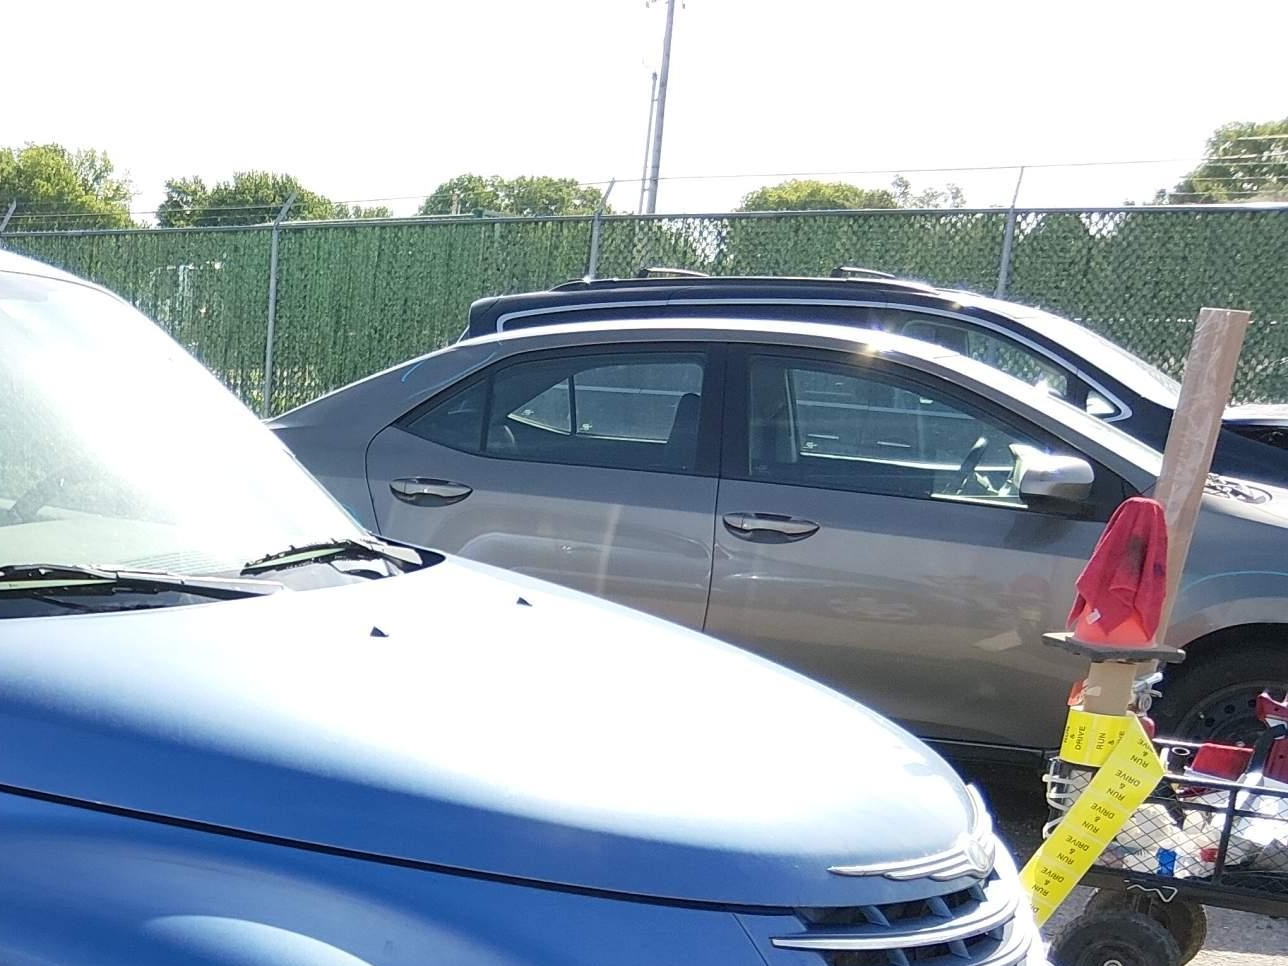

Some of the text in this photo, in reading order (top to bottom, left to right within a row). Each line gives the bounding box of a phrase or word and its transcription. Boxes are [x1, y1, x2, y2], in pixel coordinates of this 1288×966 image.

[1075, 726, 1086, 750] DRIVE
[1096, 732, 1106, 750] RUN
[1130, 754, 1150, 769] RUN
[1115, 769, 1141, 788] DRIVE
[1106, 788, 1125, 801] RUN
[1090, 802, 1116, 820] DRIVE
[1082, 820, 1100, 834] RUN
[1064, 834, 1090, 852] DRIVE
[1056, 852, 1074, 865] RUN
[1040, 866, 1065, 883] DRIVE
[1032, 883, 1049, 897] RUN
